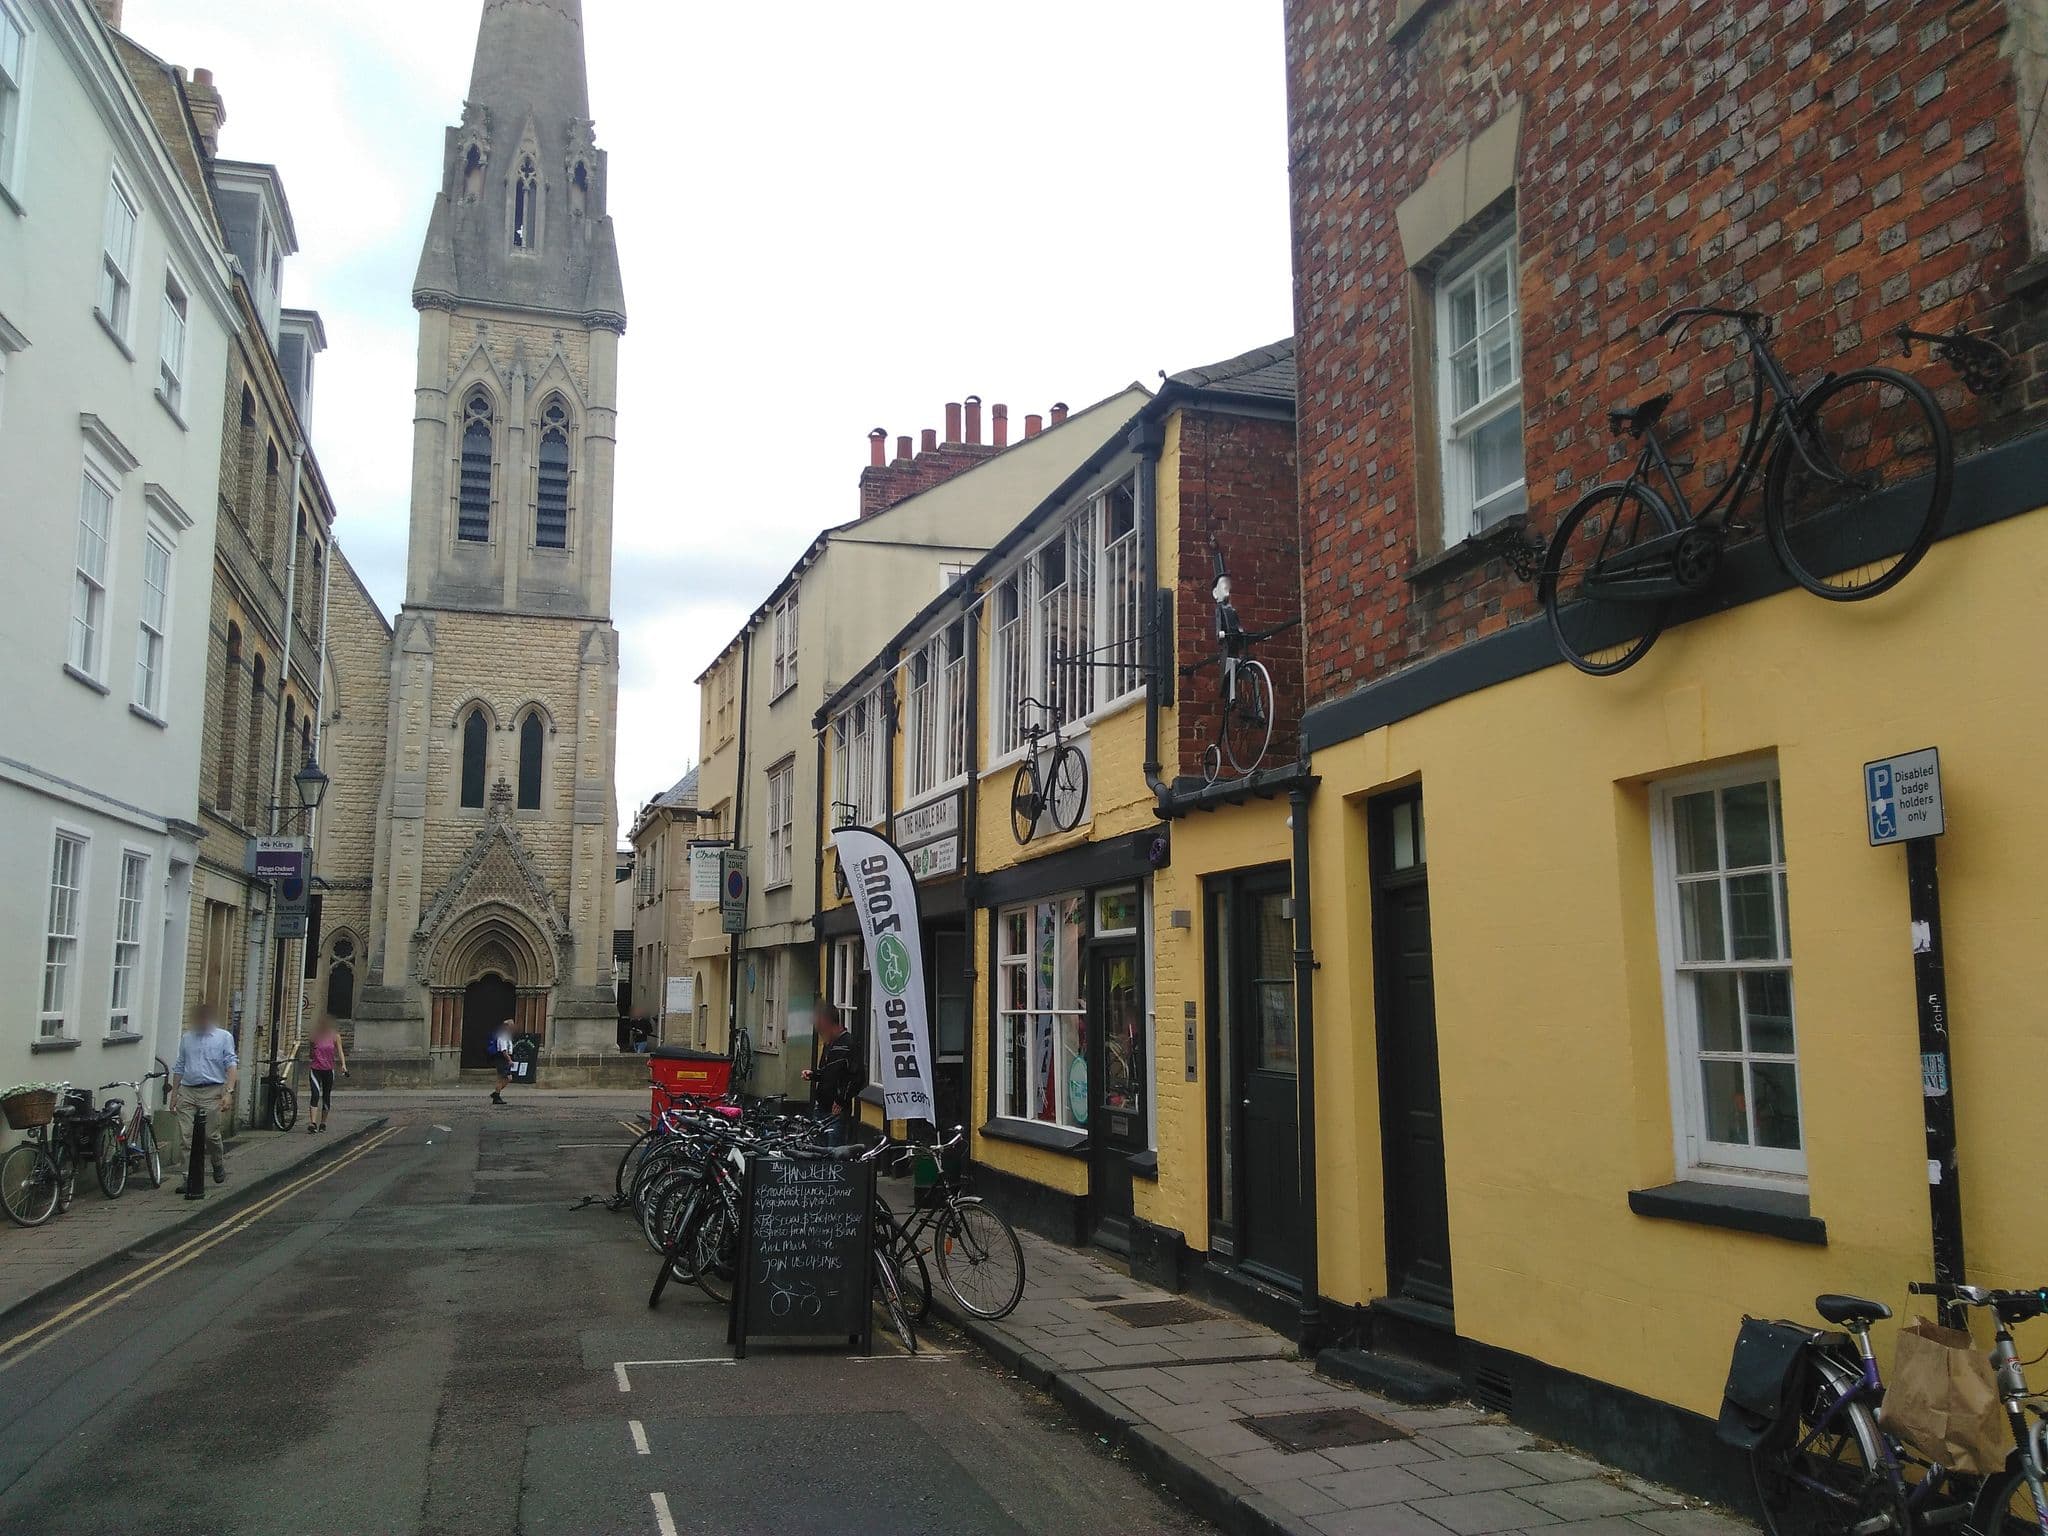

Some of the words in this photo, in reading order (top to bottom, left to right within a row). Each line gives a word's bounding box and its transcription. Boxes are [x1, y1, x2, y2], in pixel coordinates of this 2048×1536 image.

[1895, 764, 1934, 783] Disabled
[1901, 781, 1929, 795] badge
[1900, 795, 1934, 809] holders
[904, 816, 913, 836] THE
[915, 807, 935, 832] HANDLE
[936, 802, 947, 826] BAR
[1908, 809, 1927, 822] only
[272, 840, 294, 850] Kings
[728, 861, 743, 870] ZONE
[760, 1256, 787, 1284] JOIN
